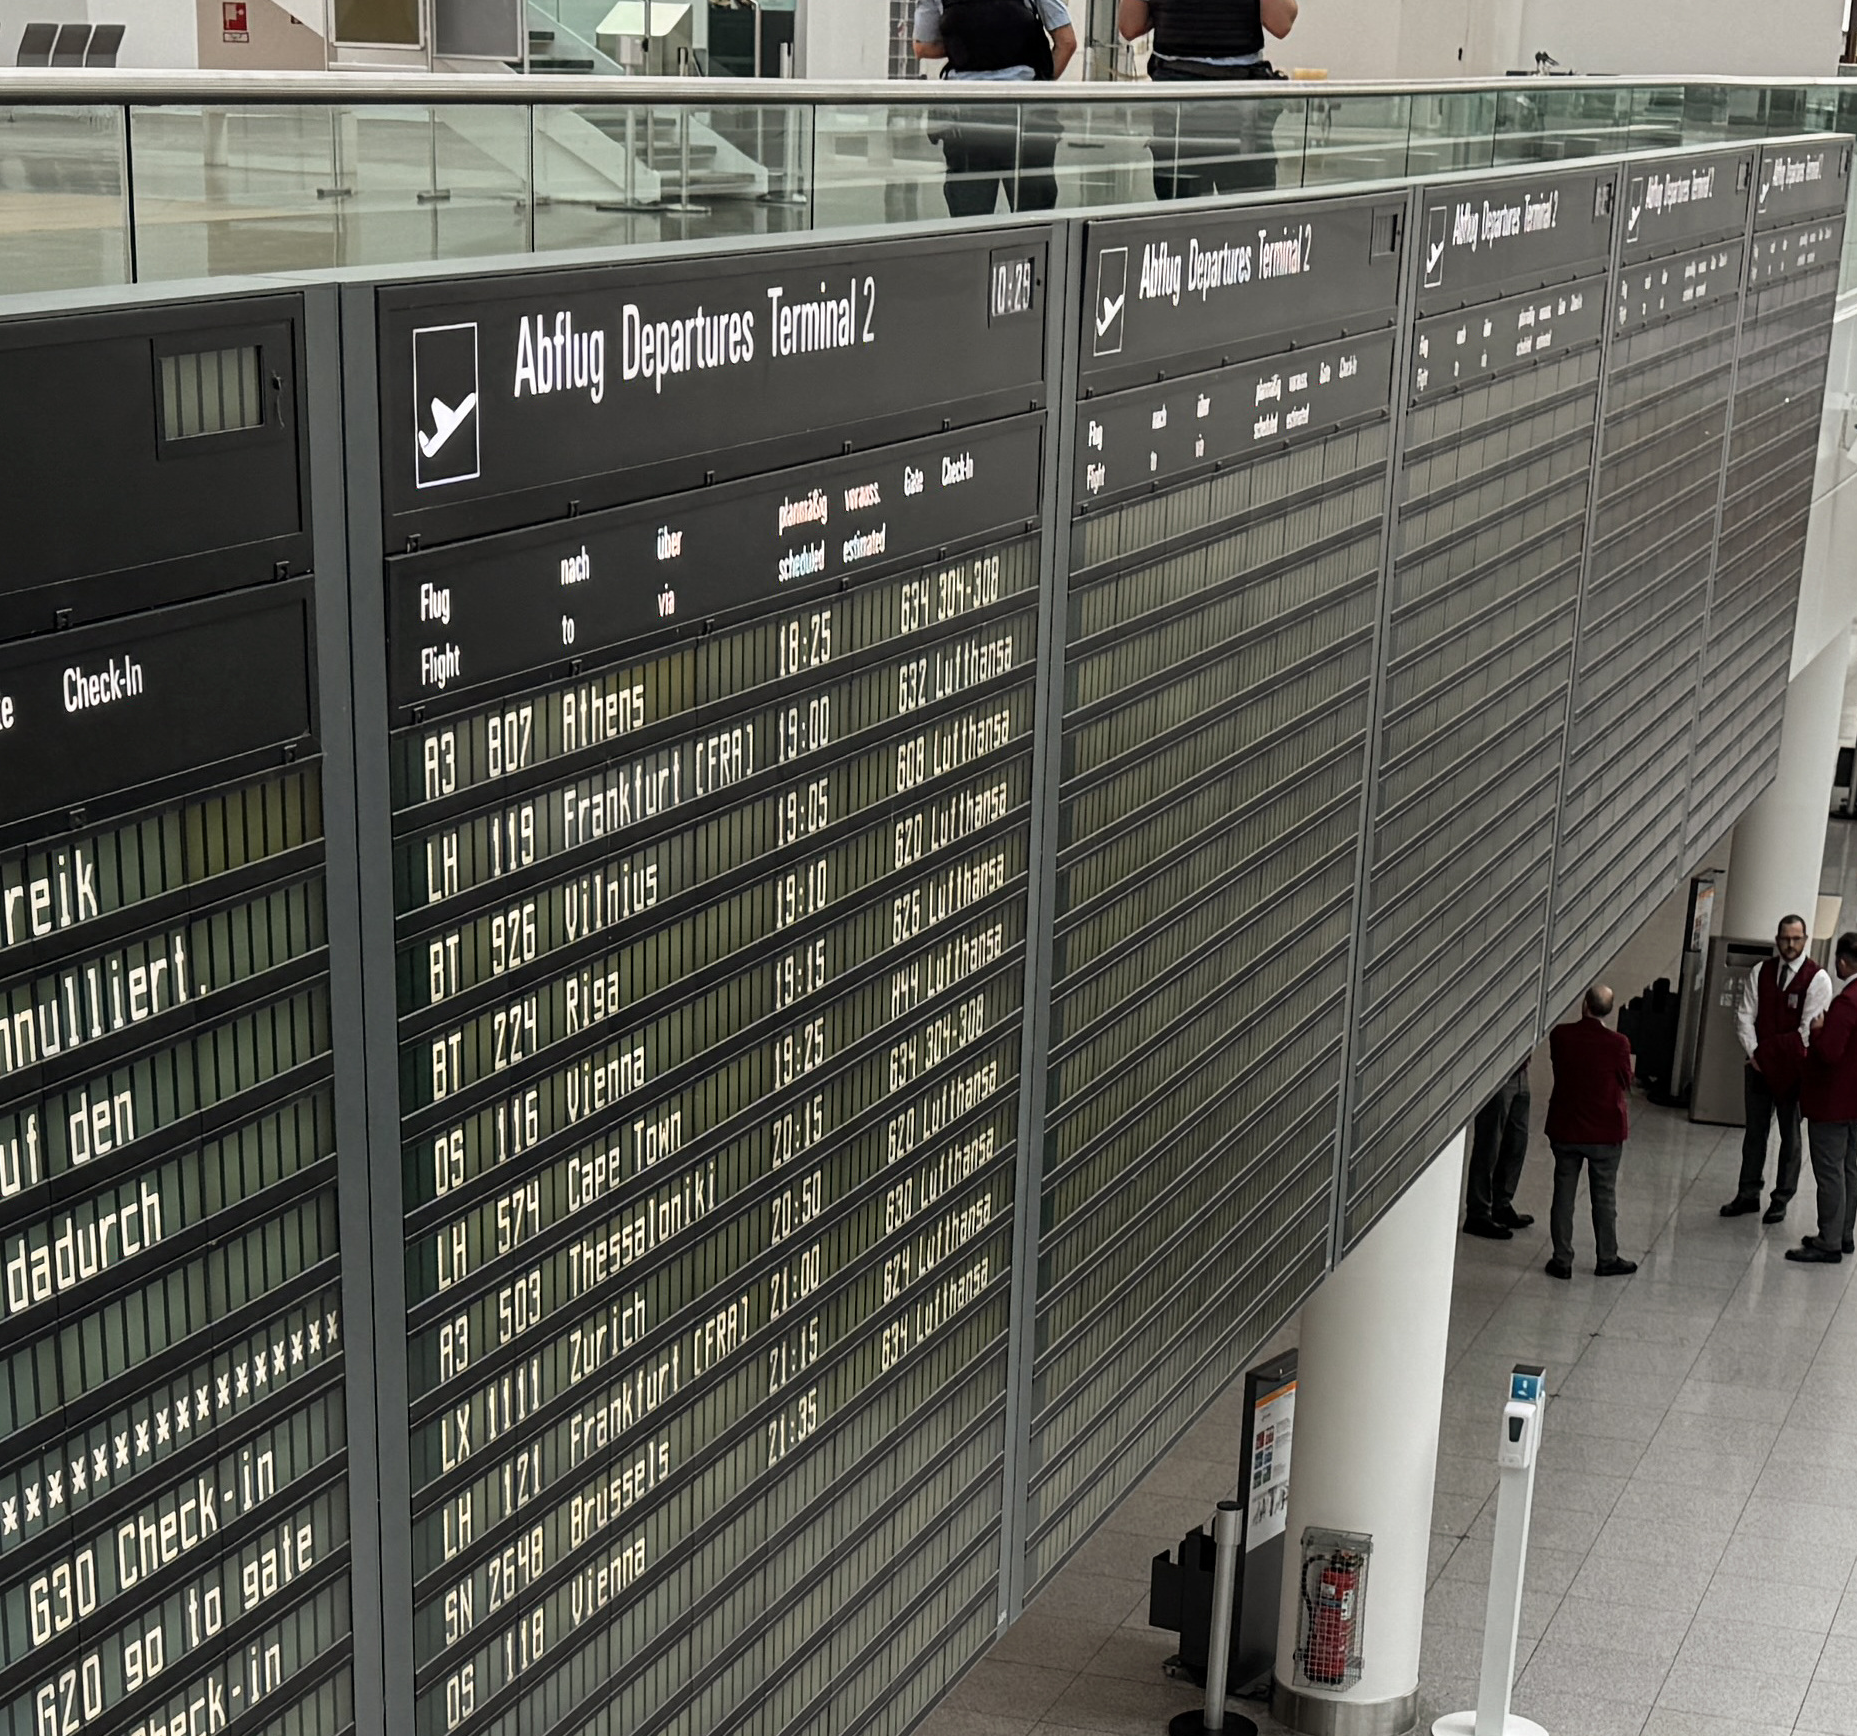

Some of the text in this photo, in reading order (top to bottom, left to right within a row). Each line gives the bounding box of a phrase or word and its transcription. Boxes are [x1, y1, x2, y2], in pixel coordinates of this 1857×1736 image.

[1139, 224, 1311, 306] Abflug Departures Terminal 2
[515, 277, 874, 403] Abflug Departures Terminal 2
[657, 525, 682, 559] über
[941, 452, 973, 485] Check-In
[420, 582, 449, 624] Flug
[560, 545, 589, 584] nach
[561, 615, 574, 644] to
[657, 583, 674, 616] via
[63, 655, 142, 711] Check-In
[421, 642, 459, 688] Flight
[488, 610, 830, 777] 807 Athens 18:25
[493, 695, 828, 876] 119 Frankfurt 19:00
[492, 778, 827, 974] 926 Vilnius 19:05
[494, 859, 826, 1069] 224 Riga 19:10
[498, 938, 824, 1161] 116 Vienna 19:15
[69, 1090, 133, 1164] den
[497, 1017, 823, 1253] 574 Cape Town 19:25
[7, 1182, 161, 1312] dadurch
[499, 1094, 822, 1343] 503 Thessaloniki 20:15
[488, 1170, 820, 1439] 1111 Zurich 20:50
[504, 1243, 819, 1515] 121 Frankfurt 21:00
[29, 1549, 95, 1646] G30
[118, 1450, 273, 1589] Check-in
[489, 1441, 668, 1612] 2648 Brussels
[124, 1625, 163, 1691] go
[188, 1586, 221, 1647] to
[243, 1523, 312, 1609] gate
